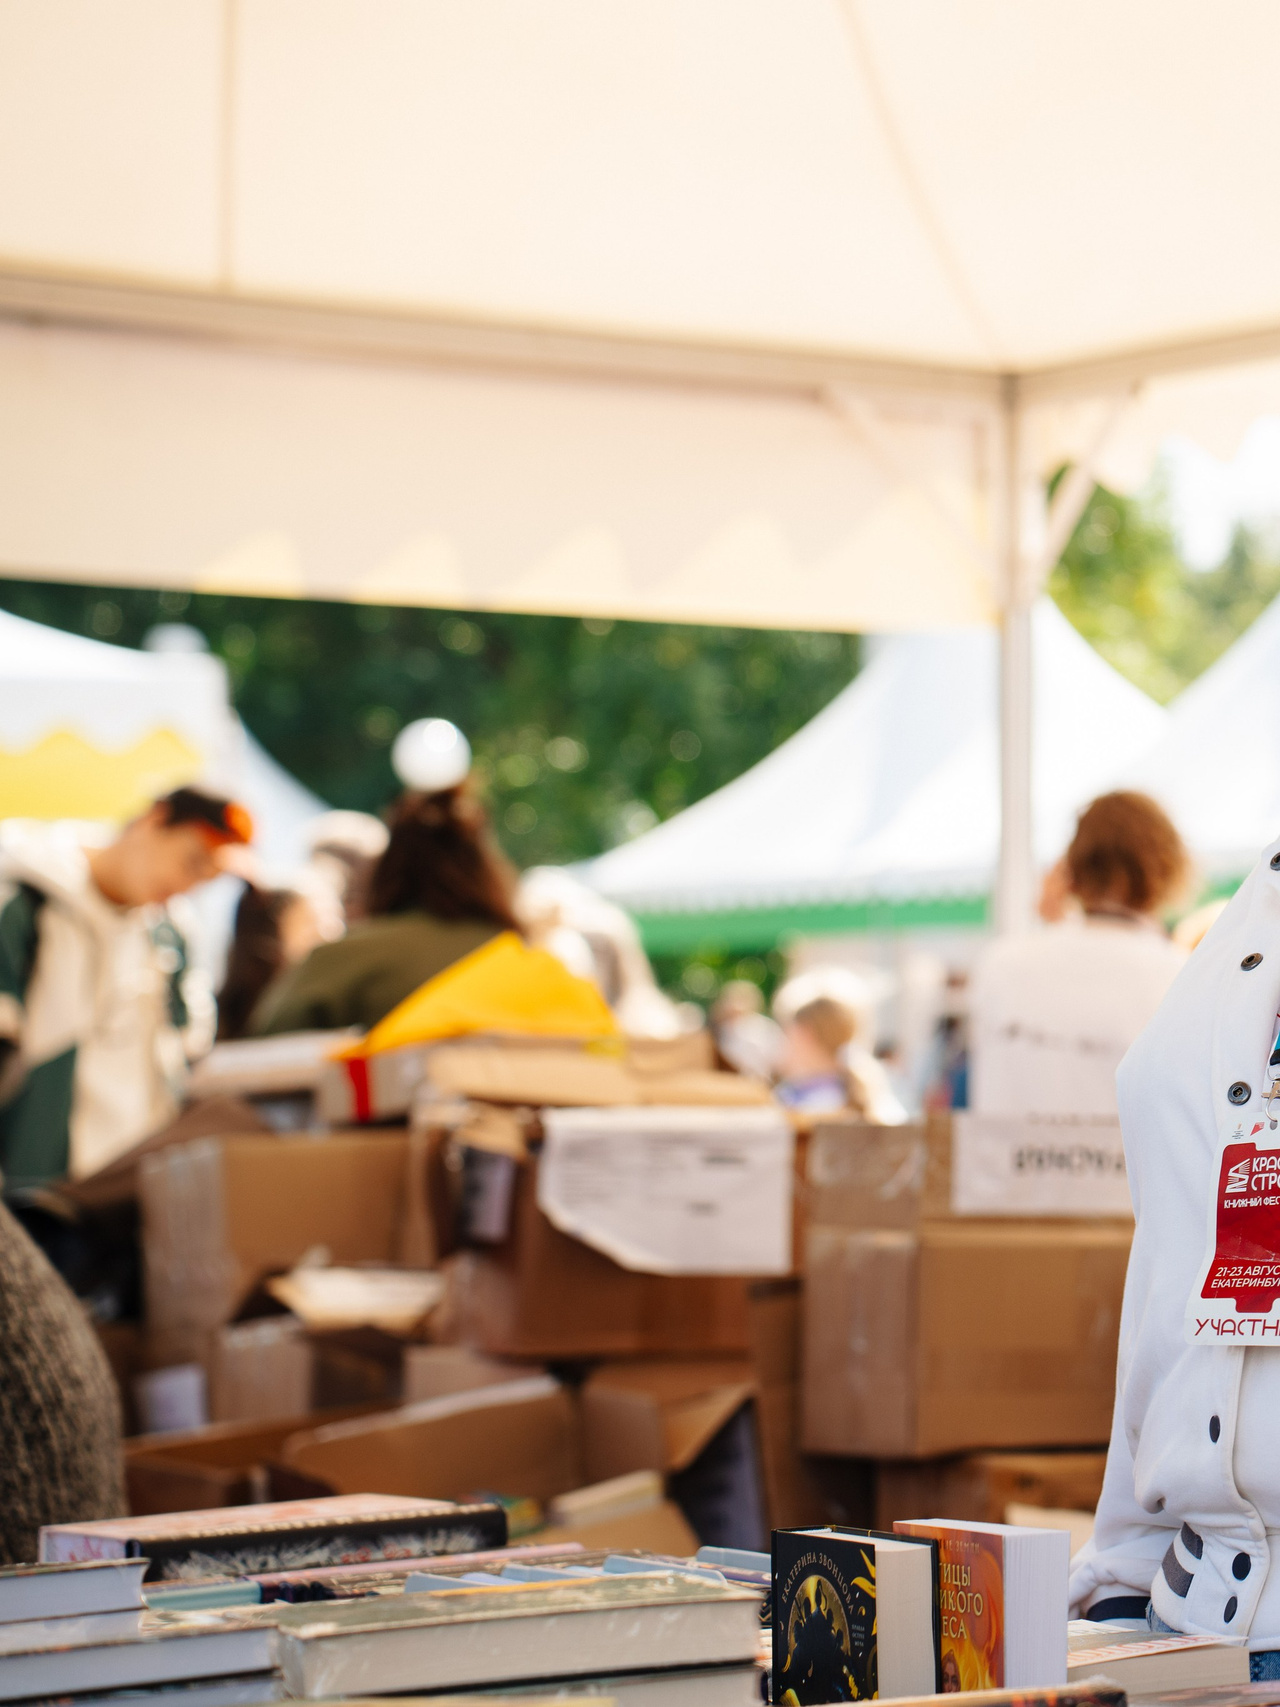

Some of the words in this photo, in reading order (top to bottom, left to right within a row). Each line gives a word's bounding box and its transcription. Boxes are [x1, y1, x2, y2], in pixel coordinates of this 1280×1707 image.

[1223, 1196, 1263, 1209] КНИЖНЫЙ
[1215, 1265, 1243, 1278] 21-23
[781, 1552, 817, 1604] ЕКАТЕРИНА
[819, 1552, 854, 1615] ЗВОНЦОВА
[939, 1589, 984, 1616] ИКОГО
[942, 1615, 967, 1640] ЕСА
